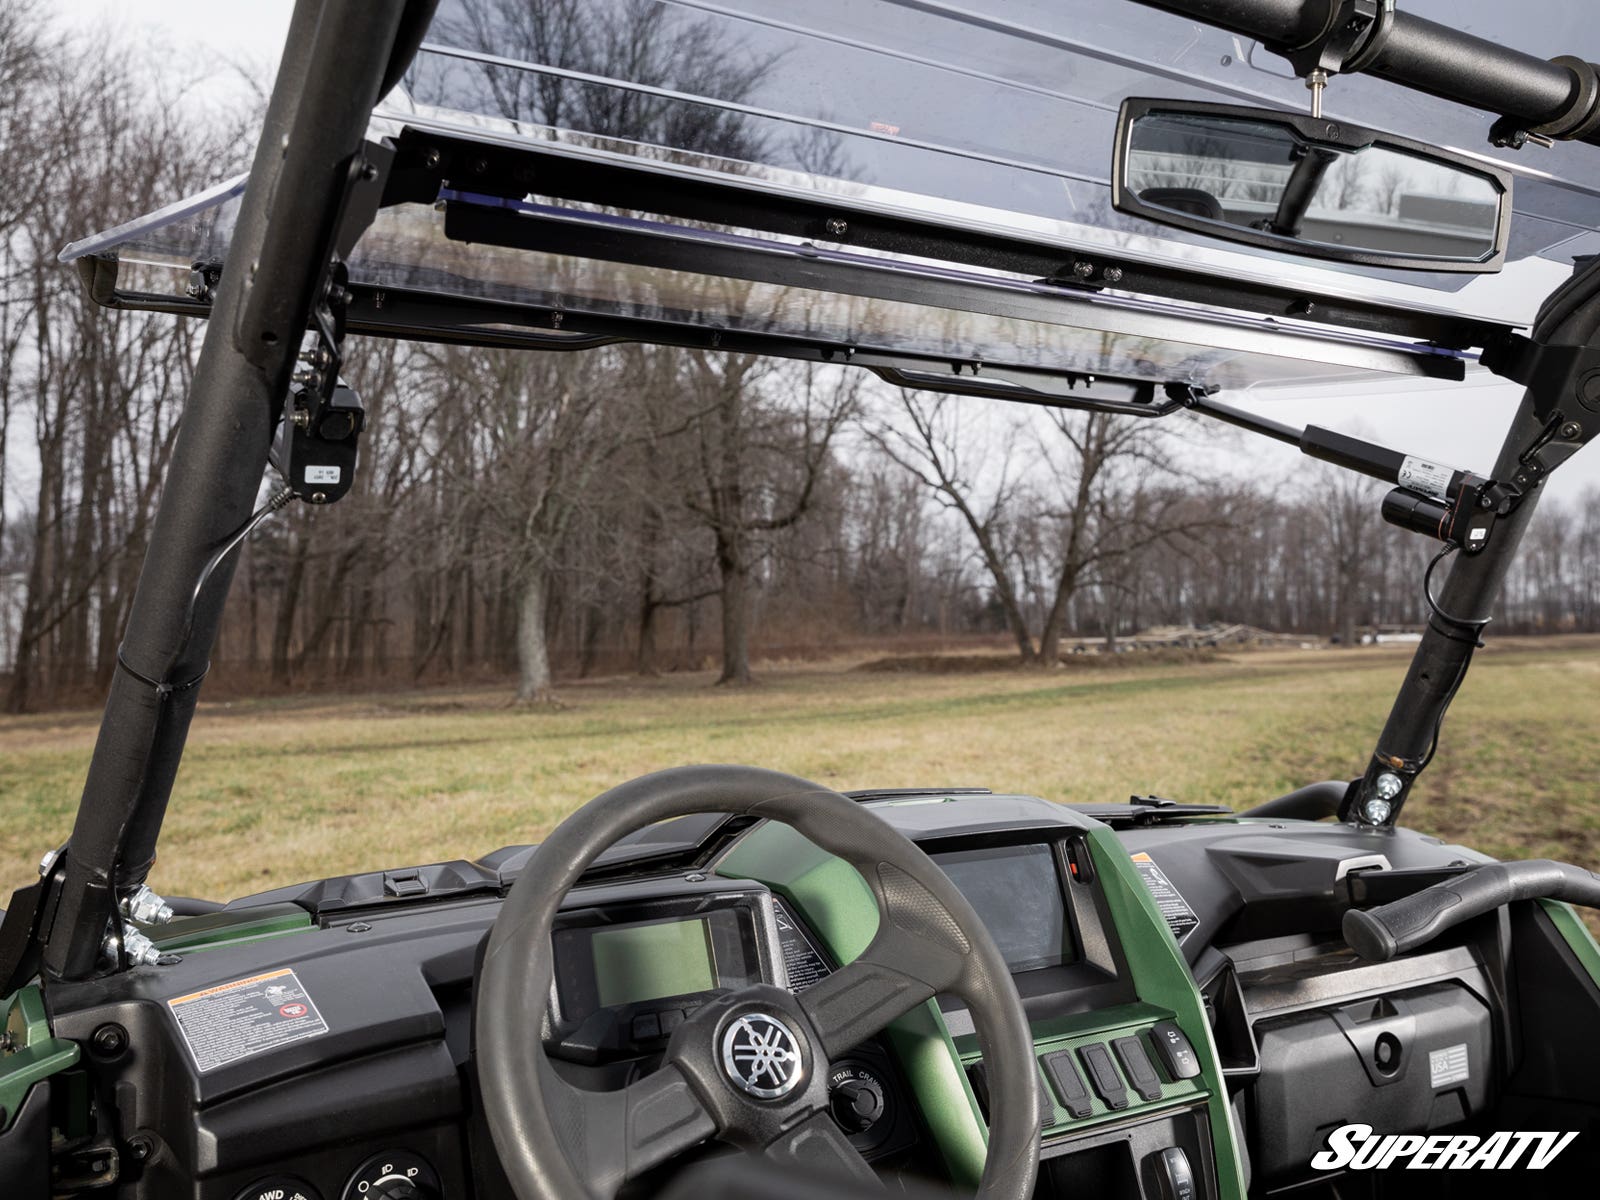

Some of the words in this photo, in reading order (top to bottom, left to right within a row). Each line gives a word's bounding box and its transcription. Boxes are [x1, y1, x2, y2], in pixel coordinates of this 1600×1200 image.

[1431, 1060, 1449, 1074] USA
[832, 1070, 854, 1083] TRAIL
[858, 1071, 880, 1087] CRAW
